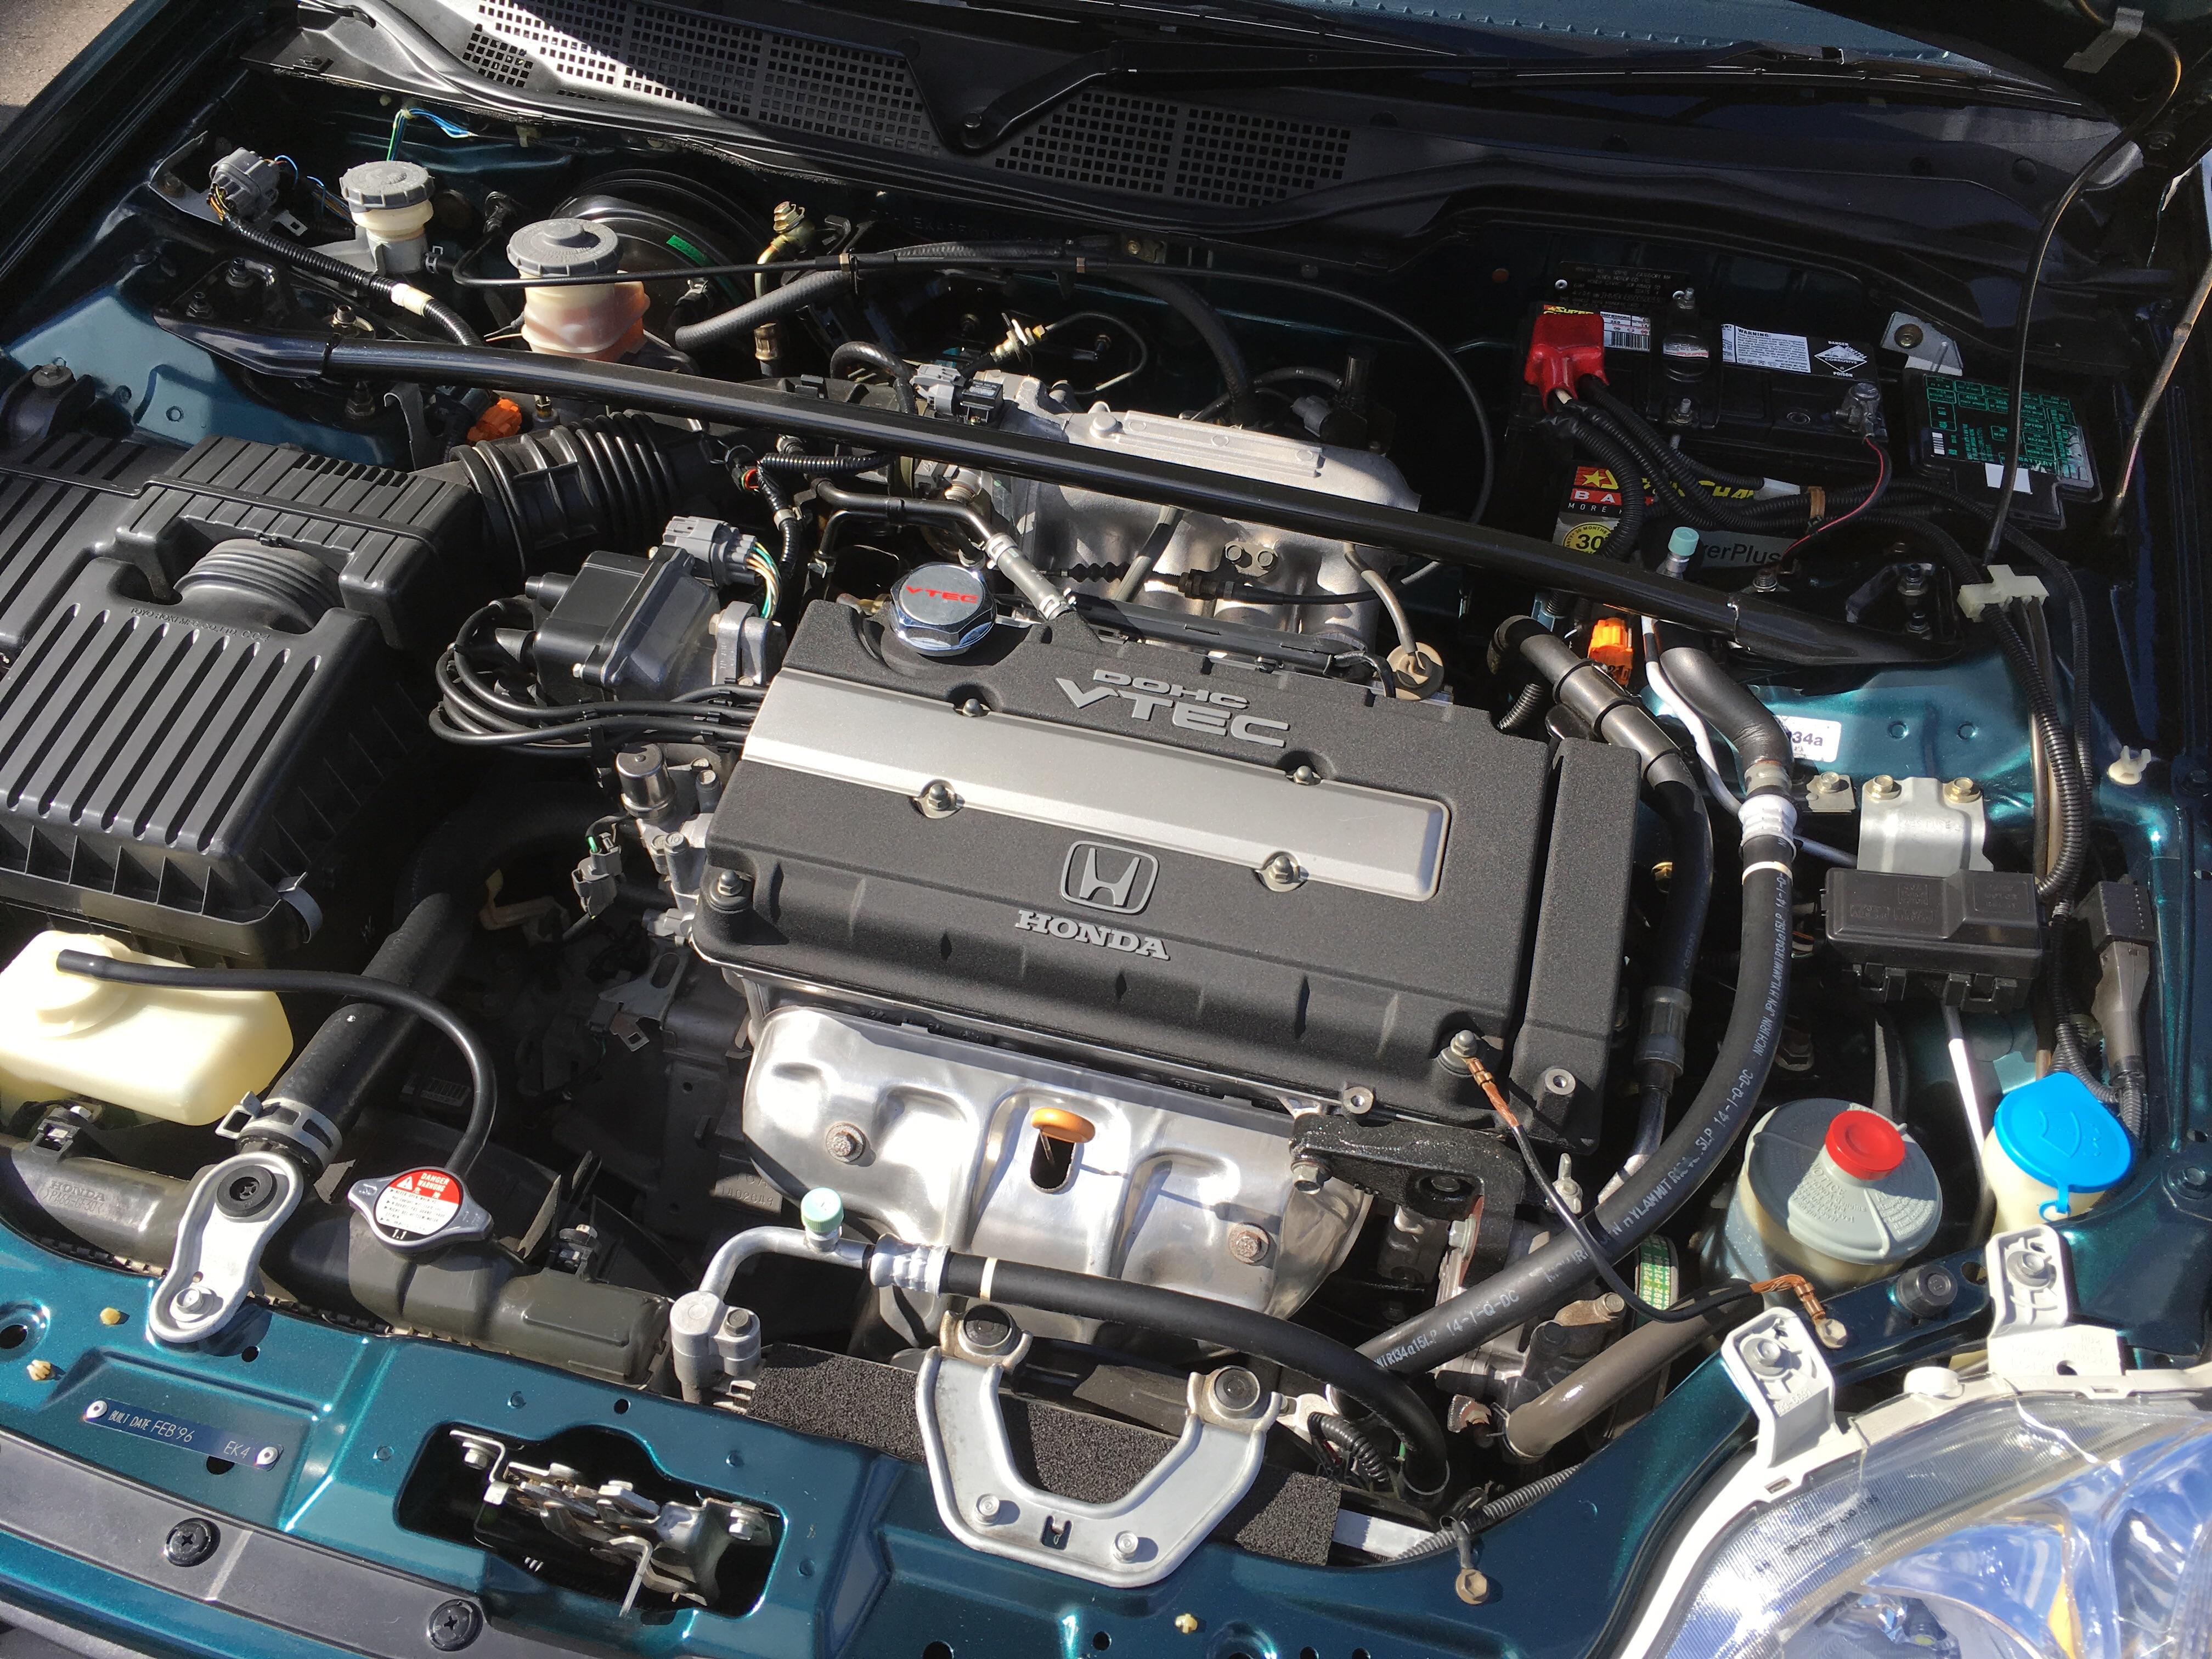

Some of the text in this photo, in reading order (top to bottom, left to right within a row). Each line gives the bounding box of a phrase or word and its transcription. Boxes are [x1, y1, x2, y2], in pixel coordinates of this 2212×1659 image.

[1567, 501, 1607, 514] MORE
[1576, 534, 1604, 550] 30
[906, 584, 979, 604] VTEC
[1093, 669, 1249, 710] DOHC
[1056, 678, 1289, 748] VTEC
[1787, 731, 1823, 747] 34a
[1015, 910, 1170, 961] HONDA
[1752, 1017, 1773, 1057] NICHIRIN
[1764, 997, 1778, 1017] JPN
[421, 1172, 450, 1185] DANGER
[1811, 1163, 1847, 1197] NOTICE
[49, 1180, 105, 1202] HONDA
[392, 1229, 407, 1240] 1.1
[108, 1409, 251, 1459] BUILT DATE FEB'96 EK4
